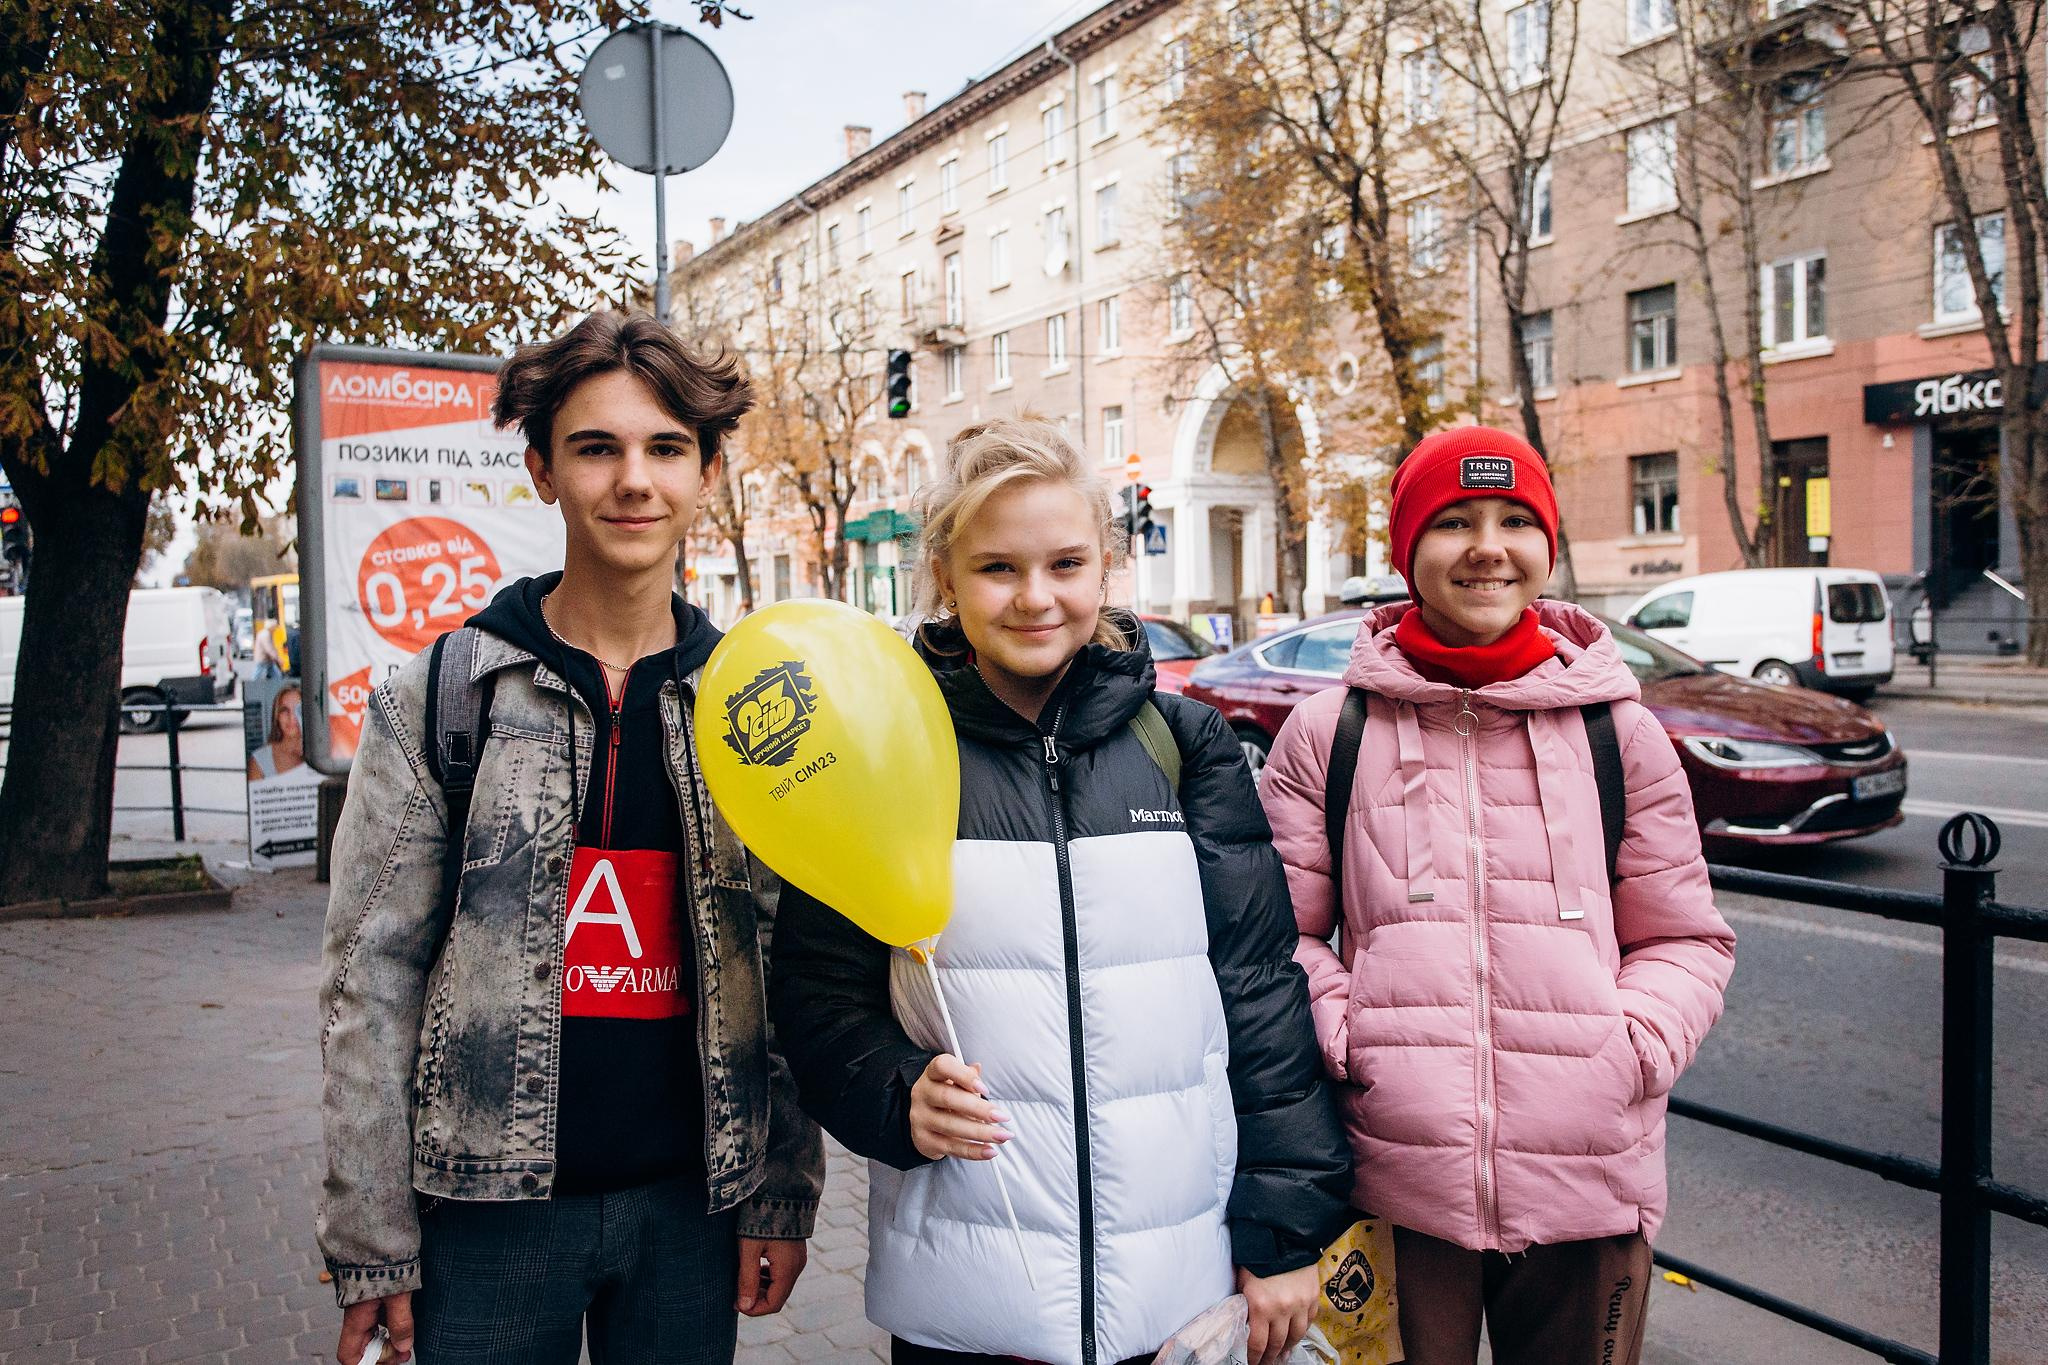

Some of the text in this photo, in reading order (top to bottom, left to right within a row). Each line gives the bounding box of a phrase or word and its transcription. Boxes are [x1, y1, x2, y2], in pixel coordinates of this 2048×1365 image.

[338, 443, 430, 465] ПОЗИКИ
[437, 449, 473, 469] ПІД
[1468, 462, 1508, 471] TREND
[371, 534, 475, 567] ставка від
[752, 720, 808, 763] ЗРУЧНИЙ МАРКЕТ
[768, 752, 838, 802] ТВІЙ СІМ23
[565, 858, 643, 959] A
[620, 965, 683, 993] ARMA
